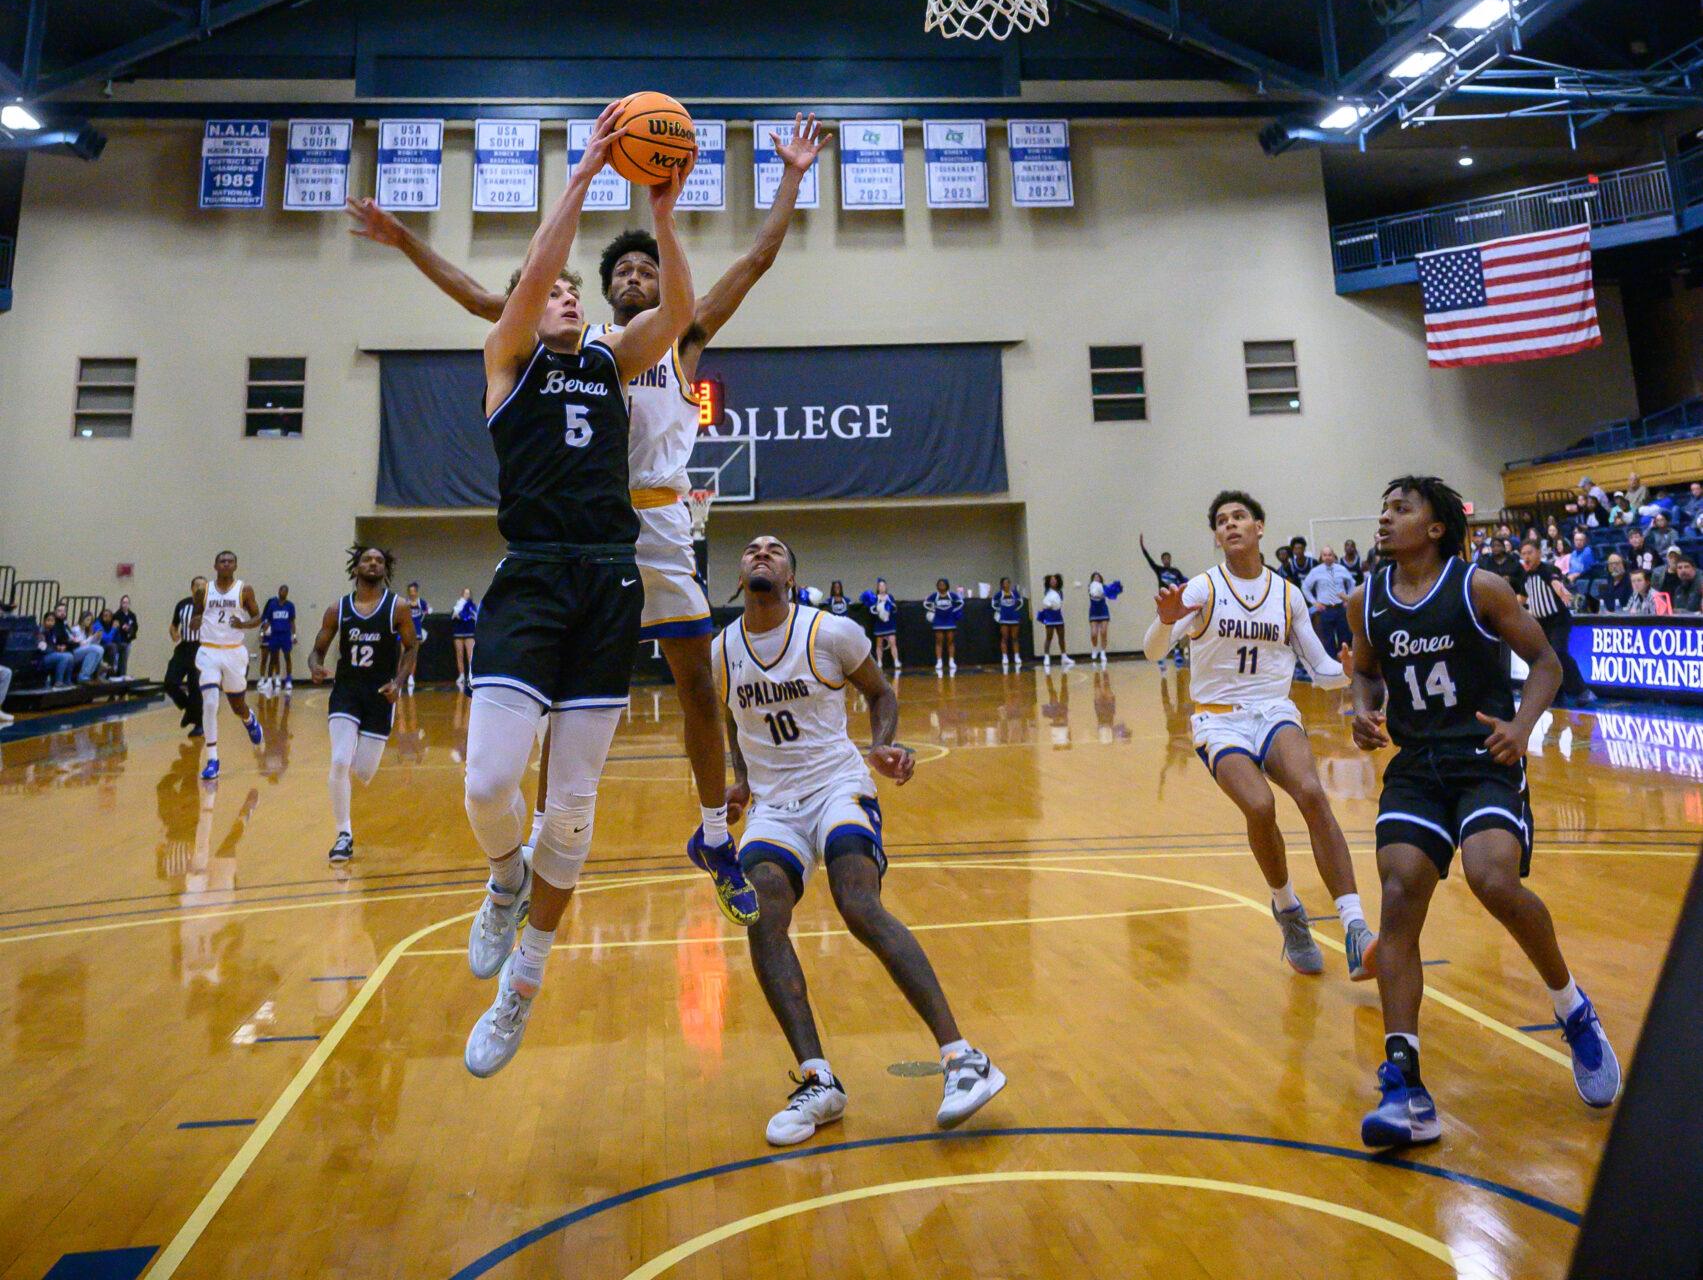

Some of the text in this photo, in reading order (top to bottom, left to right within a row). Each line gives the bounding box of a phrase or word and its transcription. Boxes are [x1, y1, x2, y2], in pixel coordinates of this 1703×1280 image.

[310, 126, 331, 135] USA
[401, 125, 421, 135] USA
[497, 126, 518, 136] USA
[302, 137, 337, 147] SOUTH
[393, 137, 428, 147] SOUTH
[490, 138, 525, 148] SOUTH
[301, 190, 331, 202] 2018
[393, 190, 423, 202] 2019
[490, 191, 521, 202] 2020
[540, 370, 608, 396] Berea
[565, 404, 594, 448] 5
[700, 404, 892, 440] OLLEGE
[209, 599, 237, 608] SPALDING
[218, 611, 225, 624] 2
[349, 627, 381, 641] Berea
[1218, 619, 1280, 641] SPALDING
[1389, 630, 1454, 657] Berea
[1592, 628, 1646, 654] BEREA
[351, 645, 374, 667] 12
[1237, 646, 1258, 674] 11
[1591, 656, 1703, 688] MOUNTAINE
[737, 679, 809, 709] SPALDING
[1404, 661, 1457, 710] 14
[764, 710, 799, 745] 10
